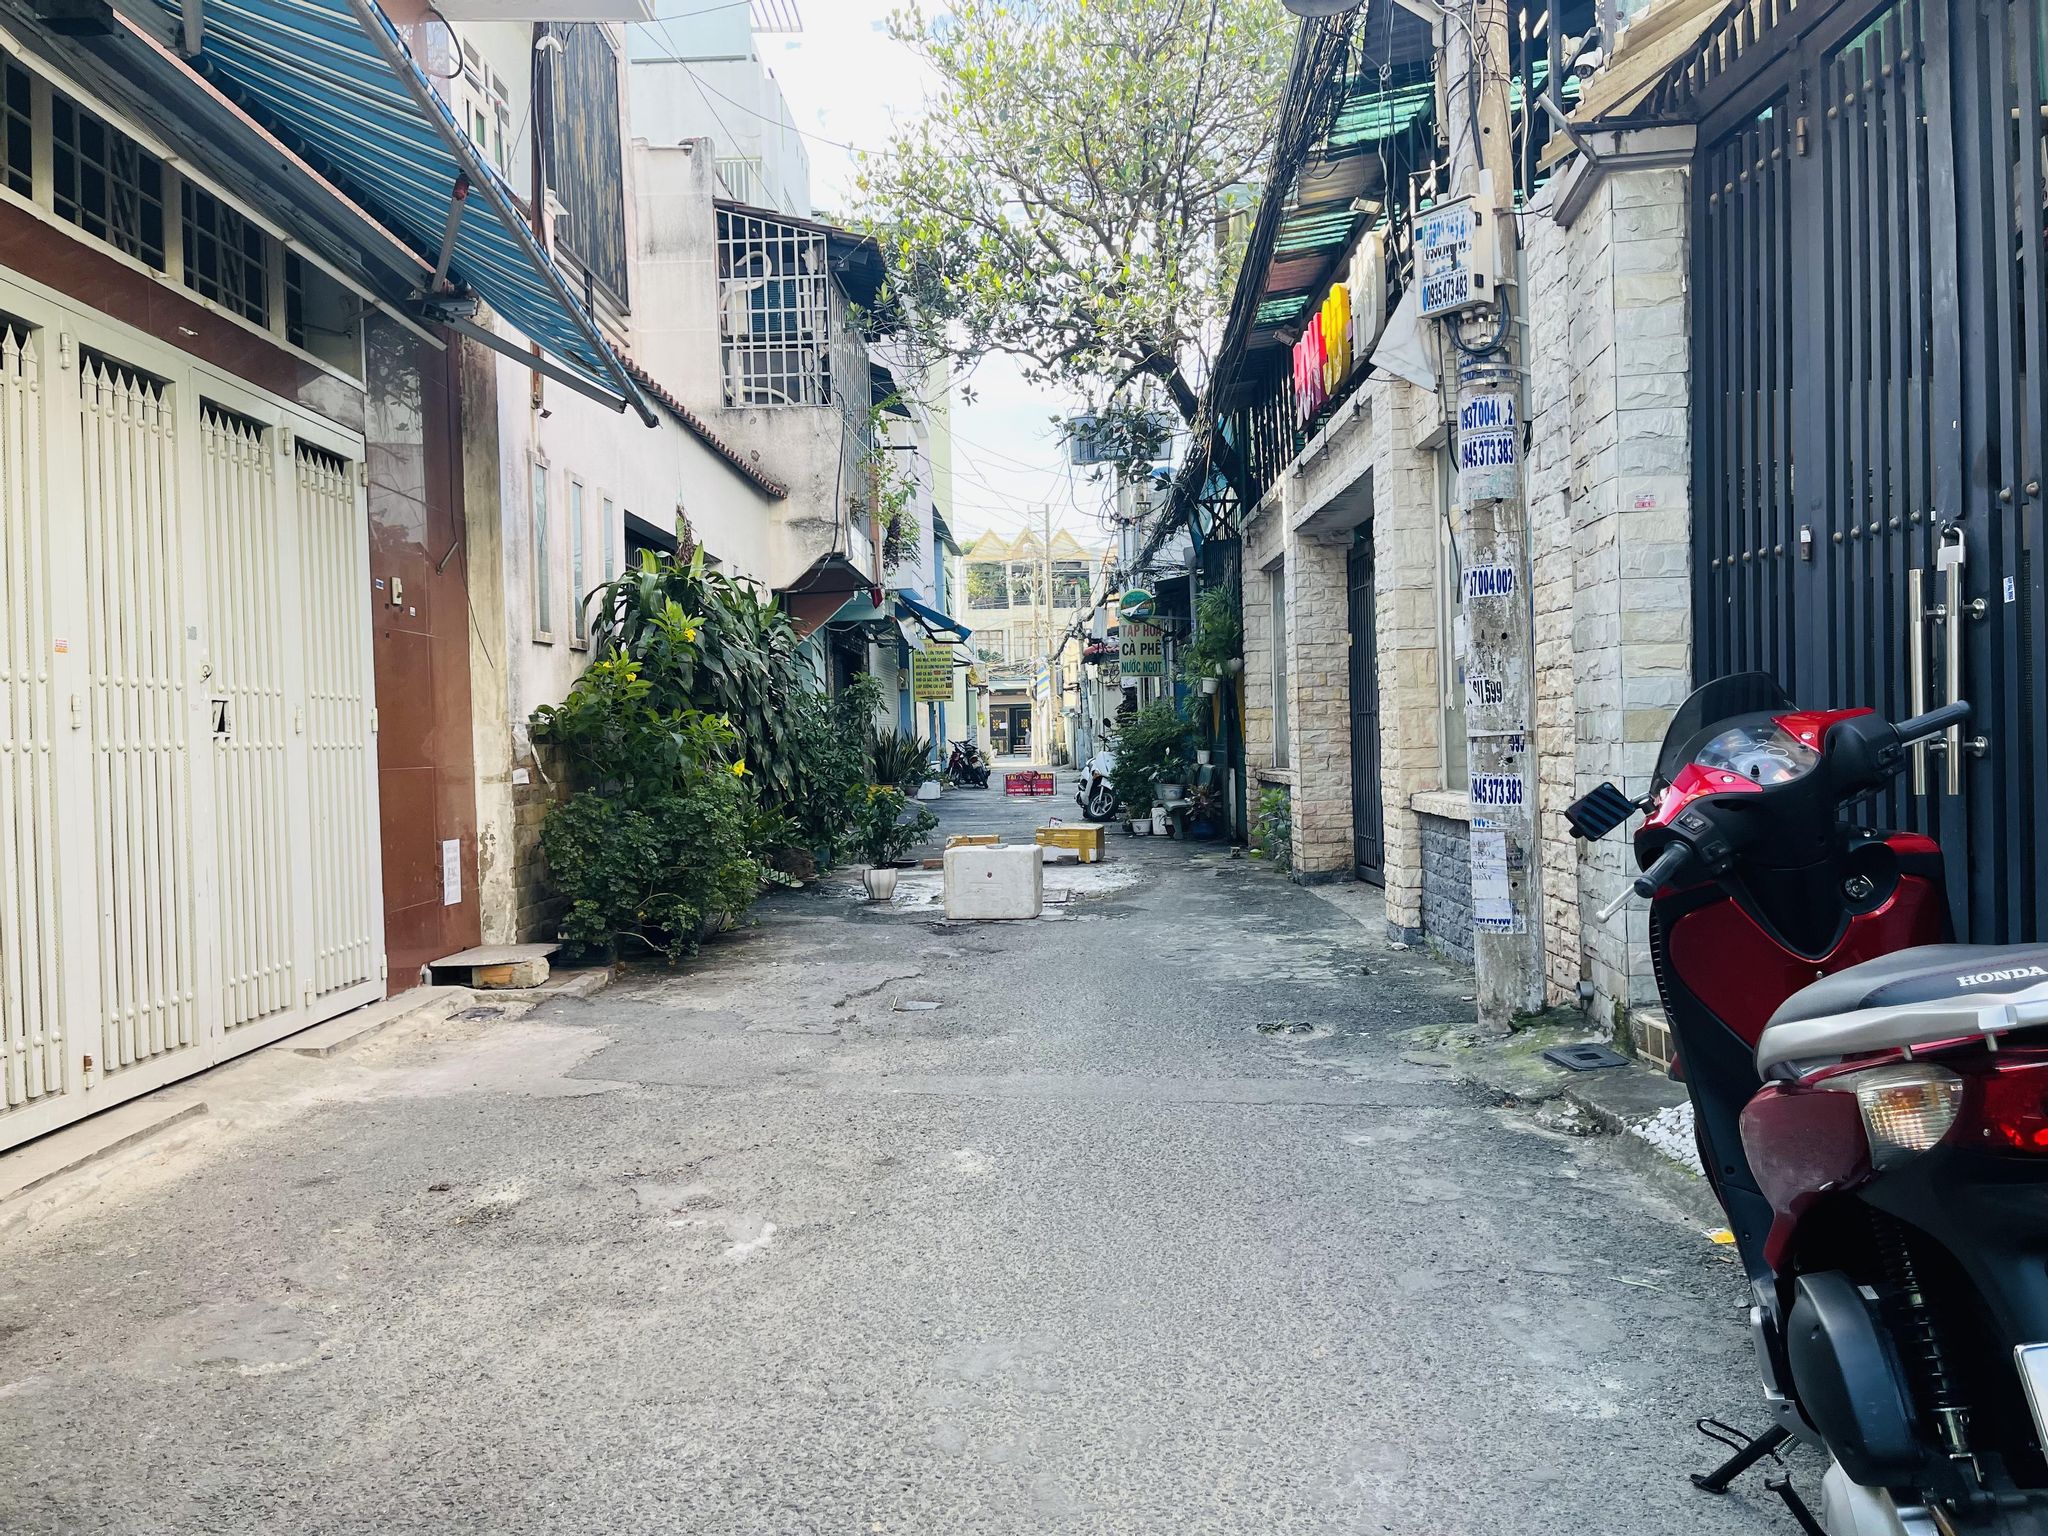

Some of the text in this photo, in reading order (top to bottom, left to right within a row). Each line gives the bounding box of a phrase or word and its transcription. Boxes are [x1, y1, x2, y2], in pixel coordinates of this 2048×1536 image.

[1122, 639, 1162, 656] CÀ PHÊ
[1956, 966, 2048, 987] HONDA
